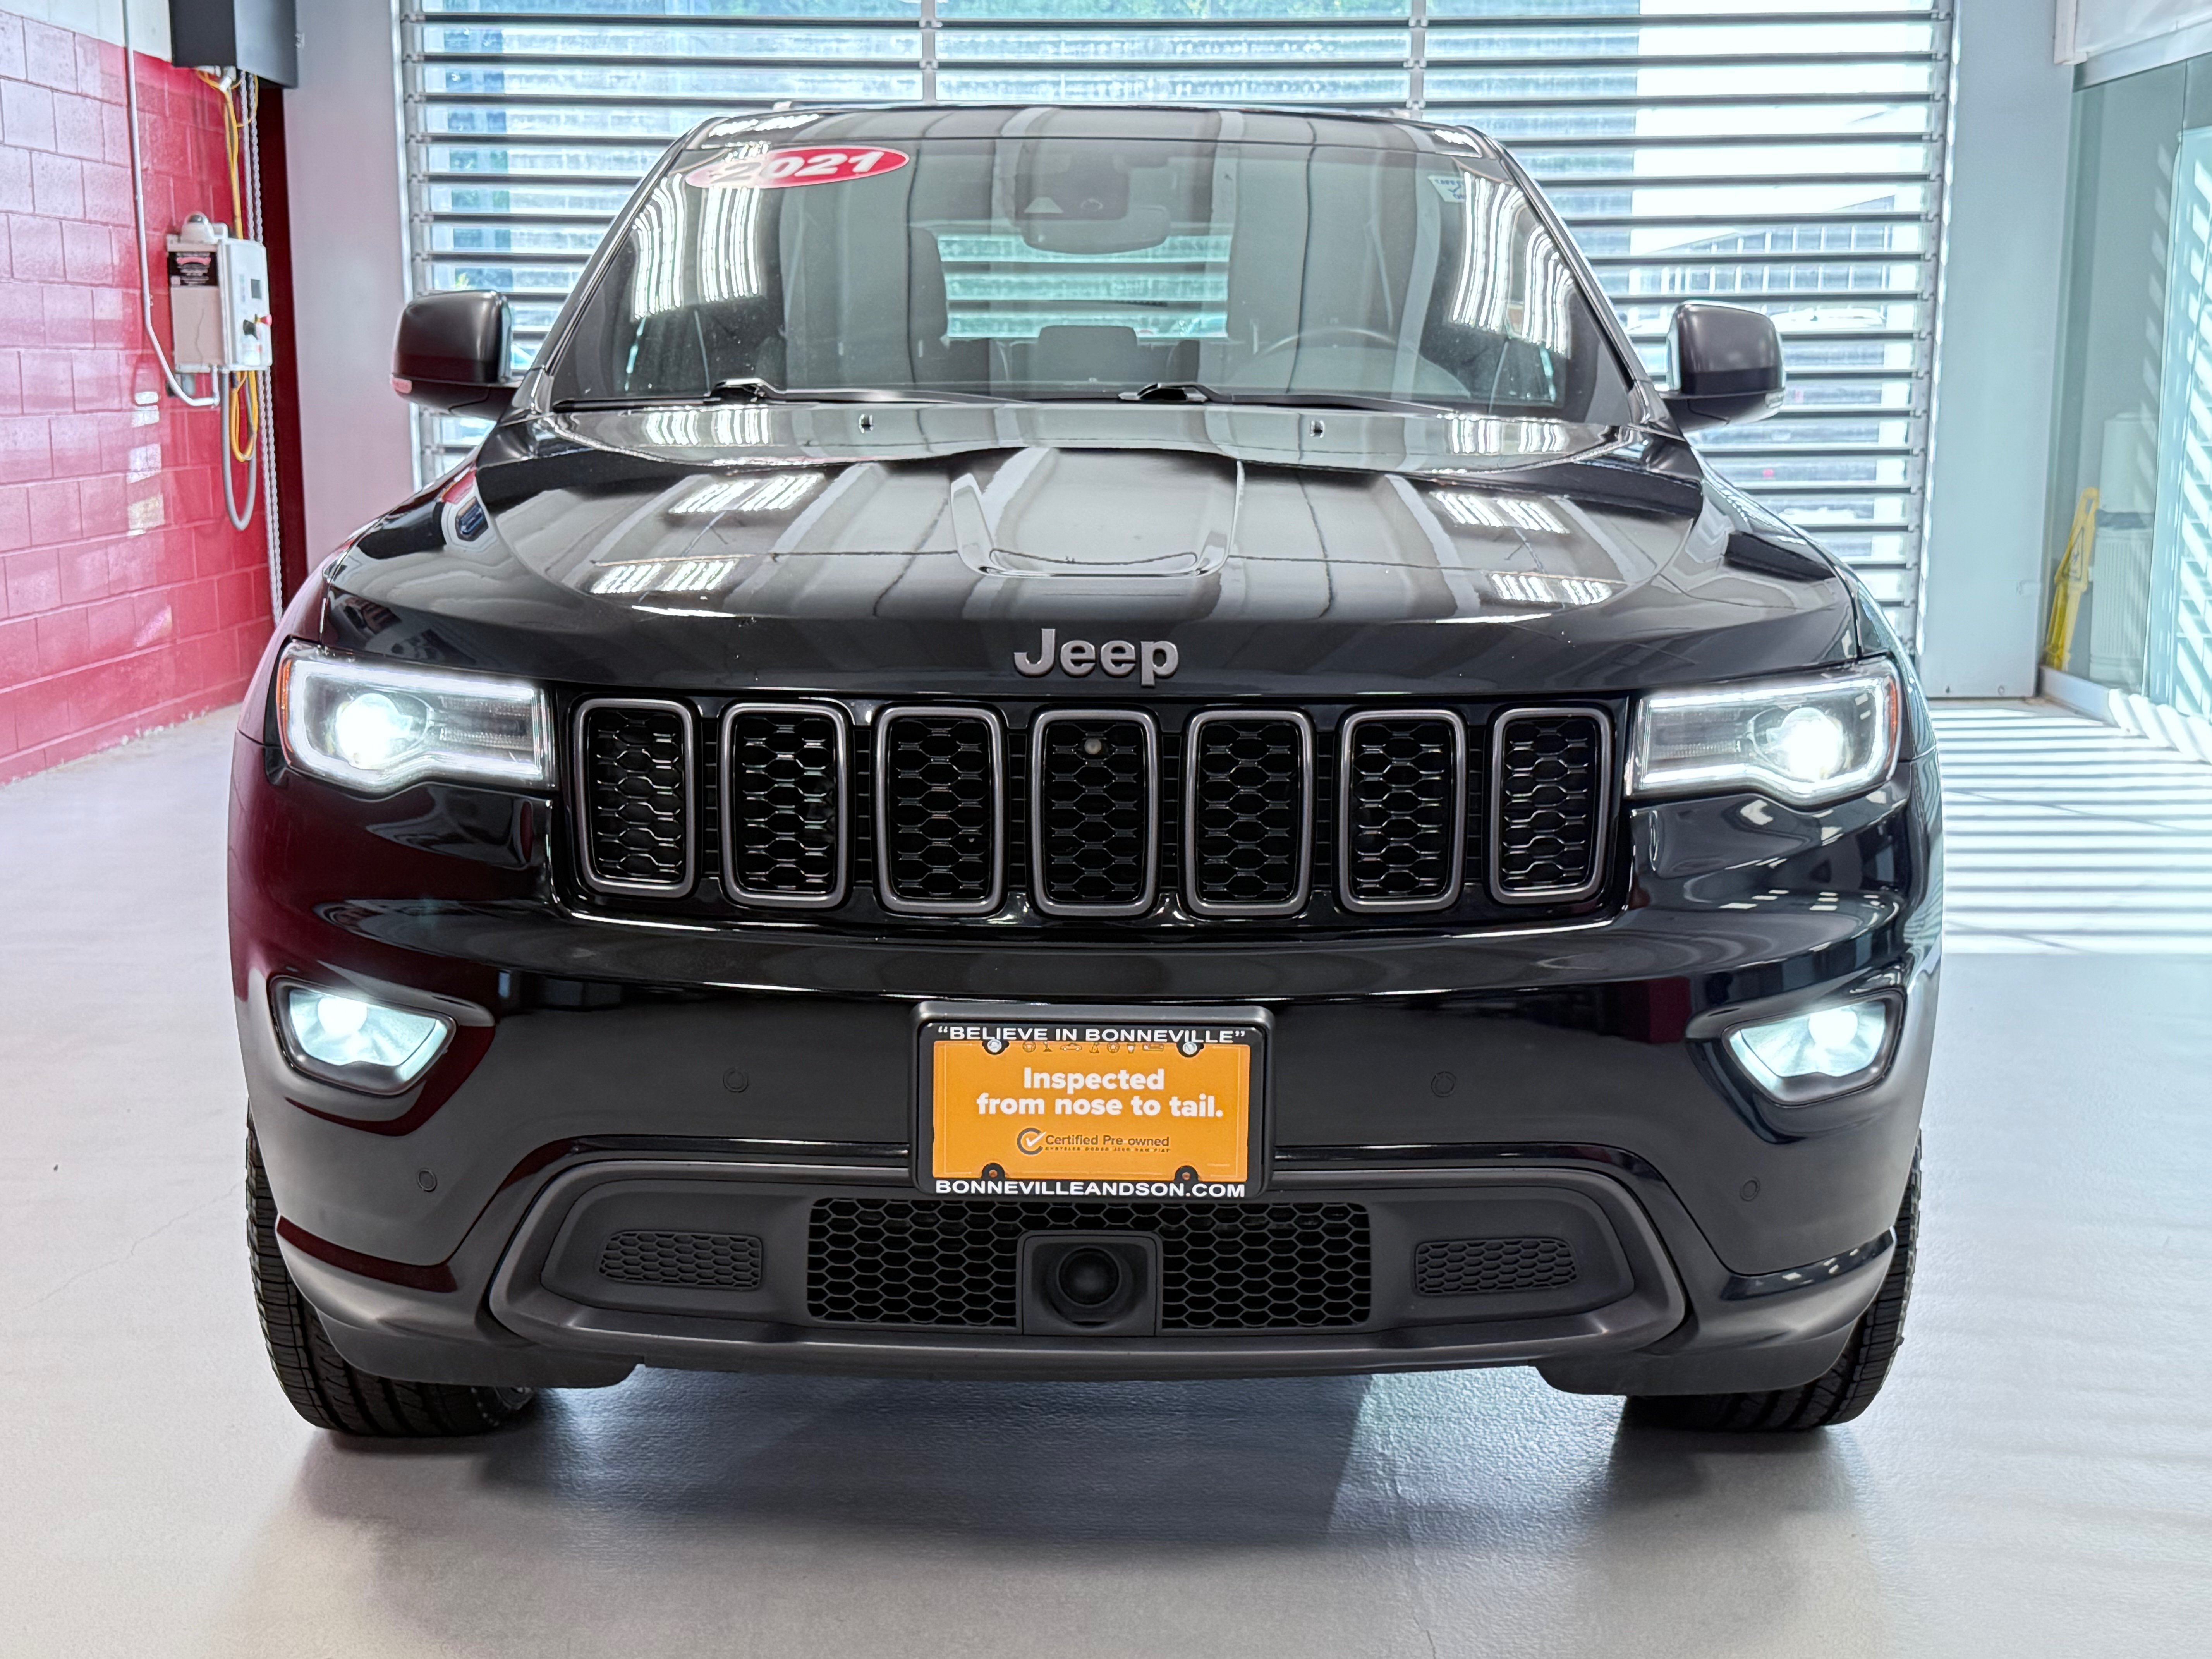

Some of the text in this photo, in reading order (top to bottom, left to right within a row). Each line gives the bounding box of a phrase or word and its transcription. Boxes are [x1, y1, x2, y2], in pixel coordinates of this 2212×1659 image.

[708, 151, 885, 184] 2021
[1013, 628, 1179, 688] Jeep
[1055, 1028, 1078, 1041] IN
[1024, 1067, 1164, 1094] Inspected
[976, 1092, 1223, 1117] from nose to tail.
[1045, 1134, 1098, 1145] Certified
[936, 1180, 1245, 1197] BONNEVILLEANDSON.COM
